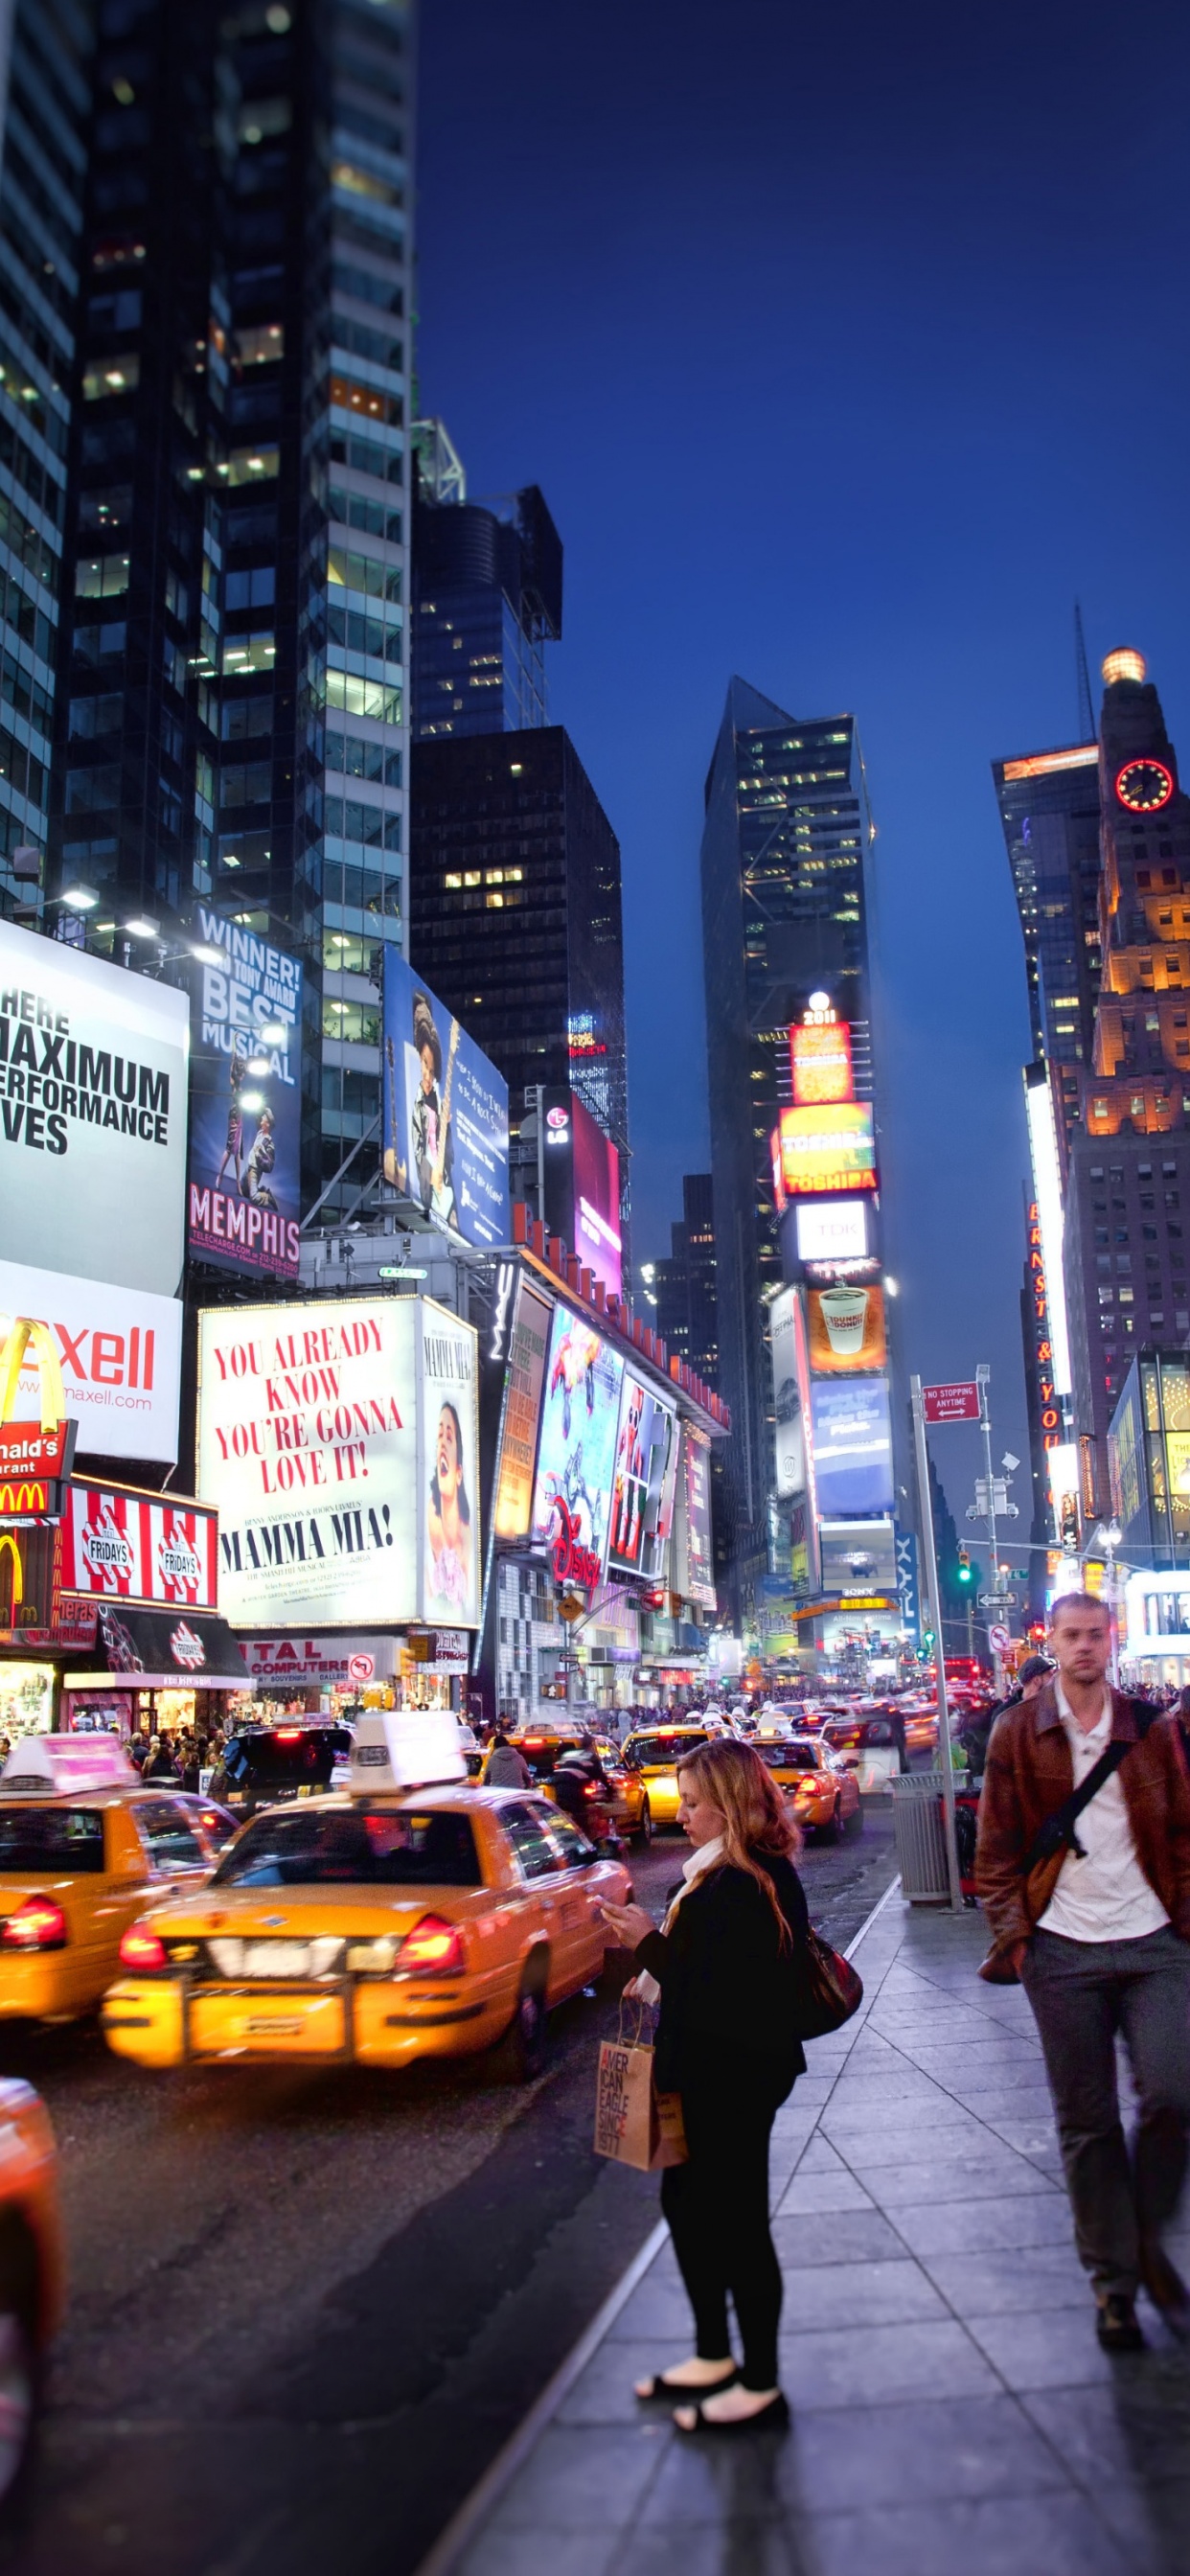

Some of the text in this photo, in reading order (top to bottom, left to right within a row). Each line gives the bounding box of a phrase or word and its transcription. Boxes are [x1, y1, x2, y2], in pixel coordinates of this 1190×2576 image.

[199, 908, 300, 992] WINNER!
[235, 959, 262, 991] TONY
[263, 976, 296, 1010] AWARD
[199, 966, 295, 1054] BEST
[803, 1010, 835, 1024] 2011
[202, 1015, 295, 1086] MUSICAL
[793, 1053, 848, 1068] TOSHIBA
[547, 1130, 569, 1144] LG
[783, 1131, 874, 1153] TOSHIBA
[787, 1170, 876, 1193] TOSHIBA
[190, 1183, 300, 1263] MEMPHIS
[818, 1224, 858, 1237] TDK
[214, 1317, 383, 1380] YOU ALREADY
[423, 1336, 453, 1379] MAMMA
[1029, 1204, 1059, 1506] ERNST & YOU
[265, 1366, 341, 1412] KNOW
[936, 1397, 966, 1408] ANYTIME
[940, 1387, 973, 1397] STOPPING
[215, 1396, 404, 1460] YOU'RE GONNA
[0, 1461, 35, 1475] rant
[261, 1440, 369, 1494] LOVE IT!
[219, 1504, 394, 1574] MAMMA MIA!
[297, 1561, 326, 1575] MUSICAL
[842, 1587, 876, 1597] SONY
[251, 1660, 349, 1675] COMPUTERS
[270, 1674, 308, 1683] SOUVENIRS
[599, 2089, 629, 2116] EAGLE
[598, 2110, 628, 2137] SINCE
